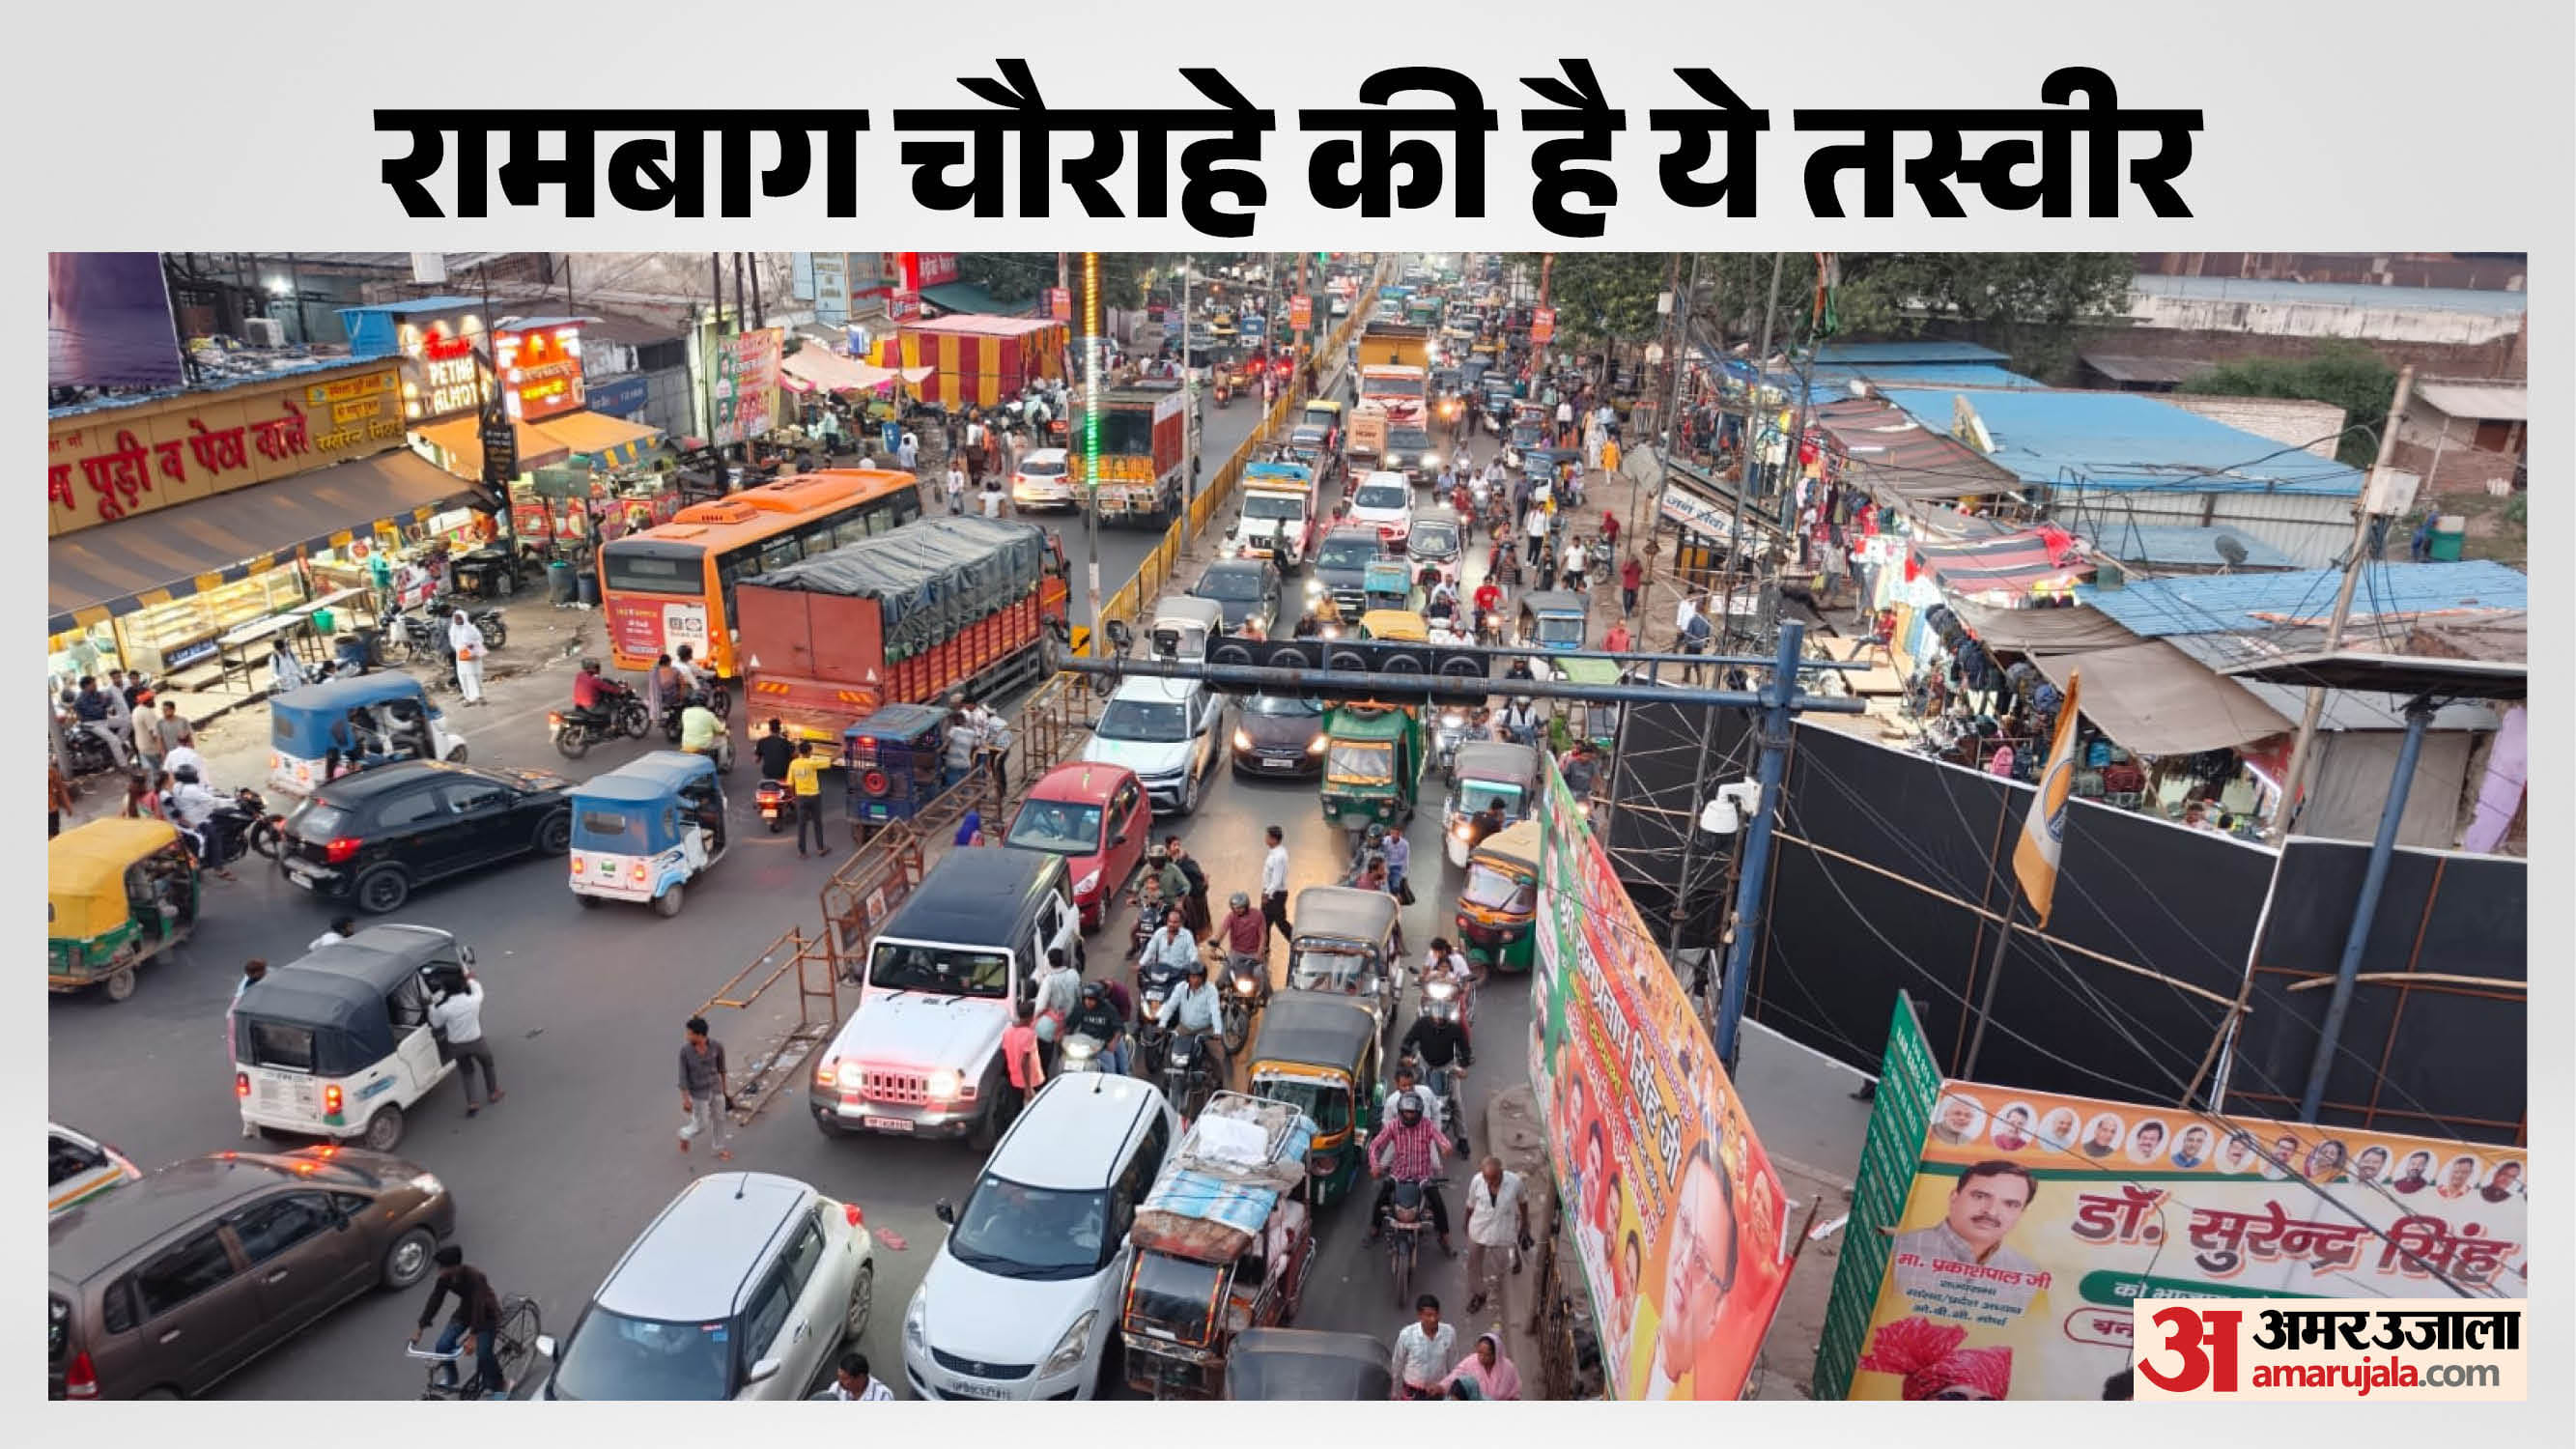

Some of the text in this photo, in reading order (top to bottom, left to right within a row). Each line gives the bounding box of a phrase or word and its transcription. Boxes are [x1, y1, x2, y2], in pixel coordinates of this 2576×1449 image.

[80, 431, 152, 523] पूड़ी
[155, 439, 186, 483] व
[188, 418, 248, 474] पेठा
[250, 402, 310, 462] वाले
[1898, 1253, 1924, 1267] मा.
[2025, 1270, 2052, 1290] जी
[2071, 1184, 2520, 1288] डॉ. सुरेन्द्र सिंह
